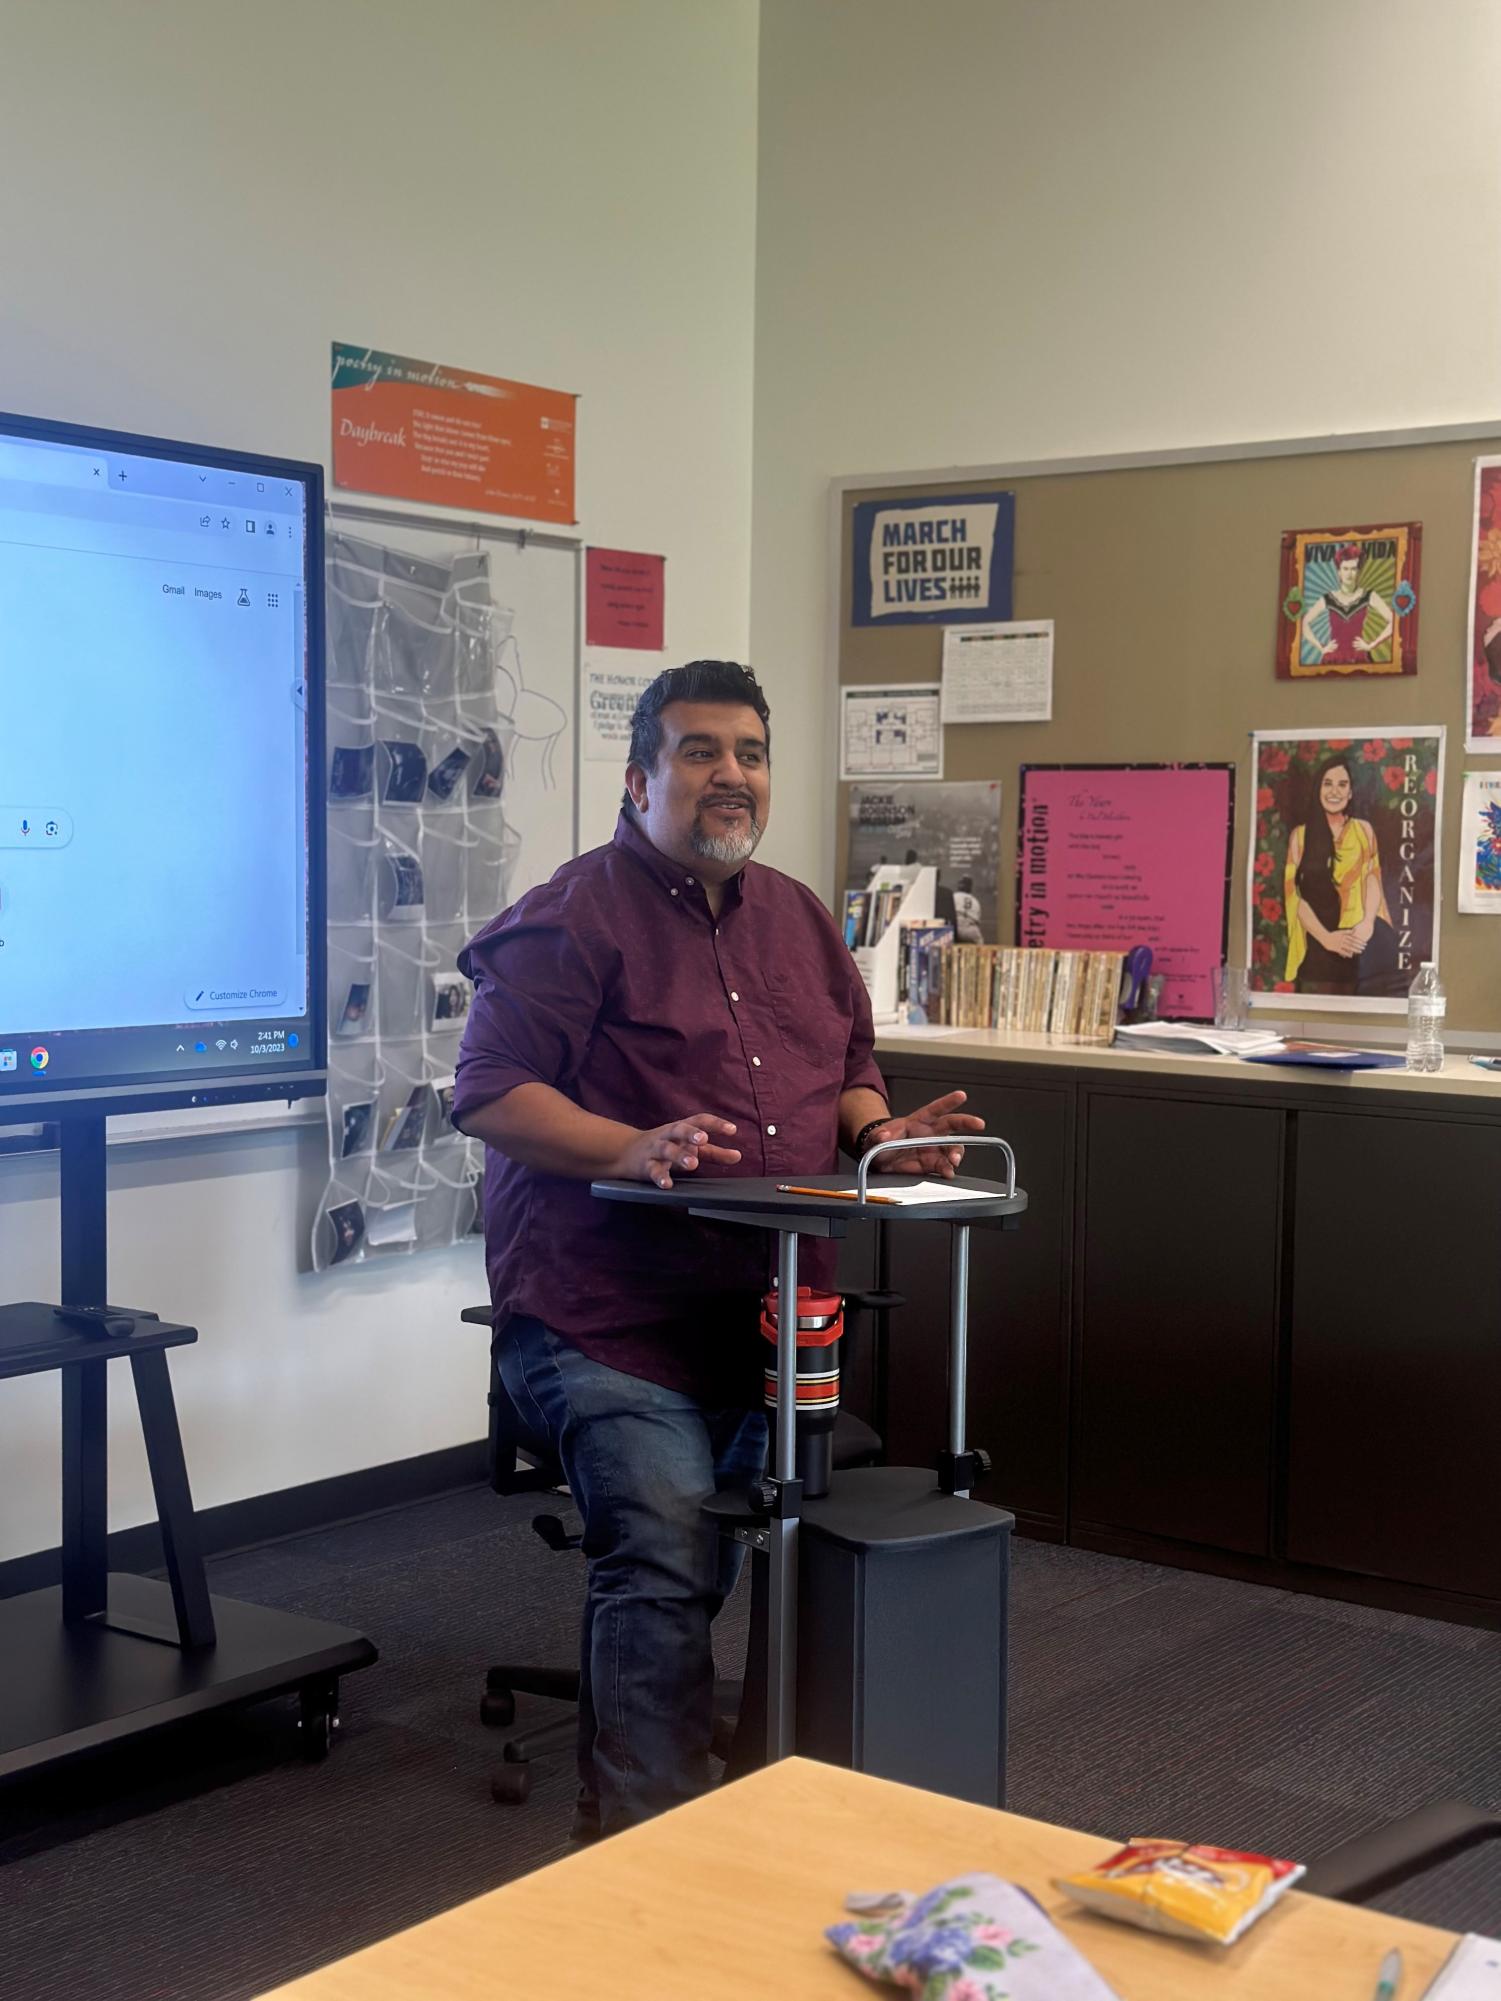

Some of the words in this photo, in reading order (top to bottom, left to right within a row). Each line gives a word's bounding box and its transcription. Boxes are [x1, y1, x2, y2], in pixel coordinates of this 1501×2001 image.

[331, 348, 382, 391] poetry
[386, 358, 402, 377] in
[407, 364, 457, 388] motion
[340, 417, 406, 447] Daybreak
[883, 518, 967, 547] MARCH
[883, 549, 927, 575] FOR
[932, 546, 981, 572] OUR
[1361, 539, 1396, 560] VIDA
[162, 584, 185, 595] Gmail
[194, 587, 223, 601] Images
[884, 577, 946, 603] LIVES
[1027, 804, 1049, 875] motion
[1398, 754, 1419, 970] REORGANIZE
[1025, 882, 1046, 899] in
[209, 991, 248, 1000] Customize
[249, 989, 278, 999] Chrome
[250, 1042, 285, 1054] 10/3/2023
[257, 1031, 272, 1041] 2:41
[273, 1030, 285, 1040] PM
